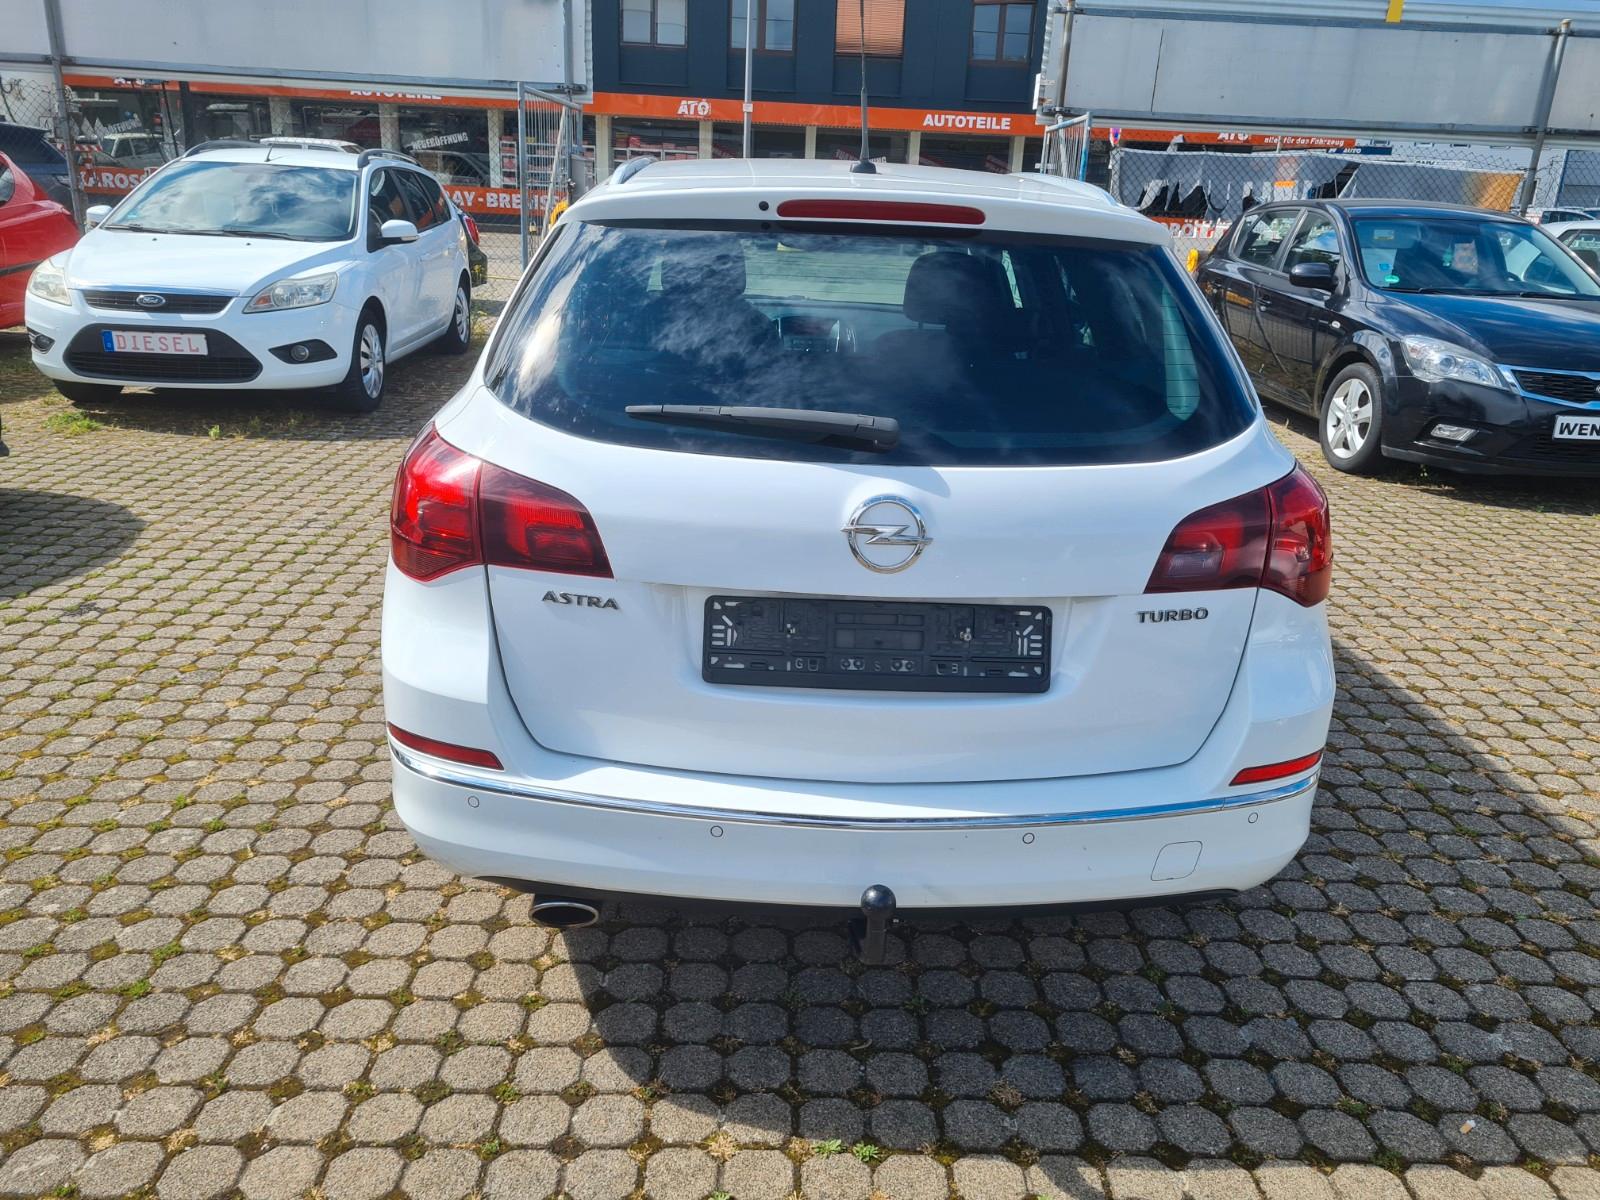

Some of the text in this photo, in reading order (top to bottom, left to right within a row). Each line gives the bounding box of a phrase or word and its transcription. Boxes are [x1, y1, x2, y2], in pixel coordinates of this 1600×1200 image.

[923, 114, 1012, 130] AUTOTEILE
[116, 334, 200, 353] DIESEL
[542, 590, 619, 610] ASTRA
[1137, 606, 1209, 623] TURBO
